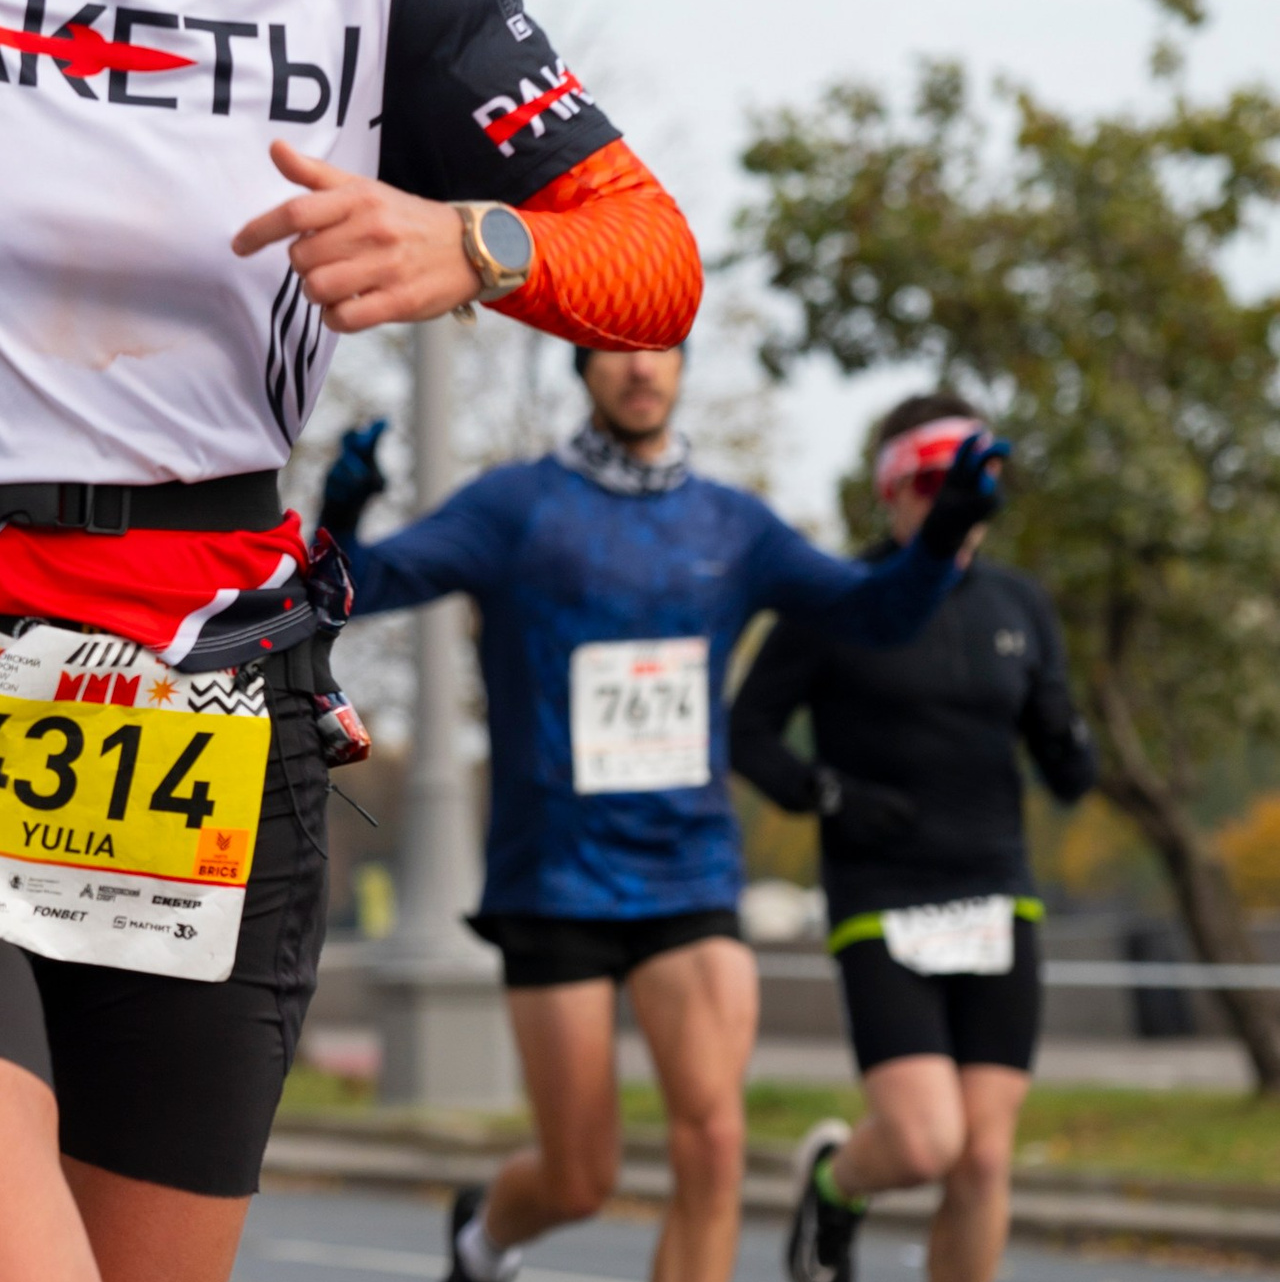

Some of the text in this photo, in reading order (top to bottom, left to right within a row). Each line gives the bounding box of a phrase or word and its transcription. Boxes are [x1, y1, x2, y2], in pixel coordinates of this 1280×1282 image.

[21, 821, 116, 858] YULIA
[198, 865, 238, 878] BRICS
[32, 905, 88, 923] FONBET
